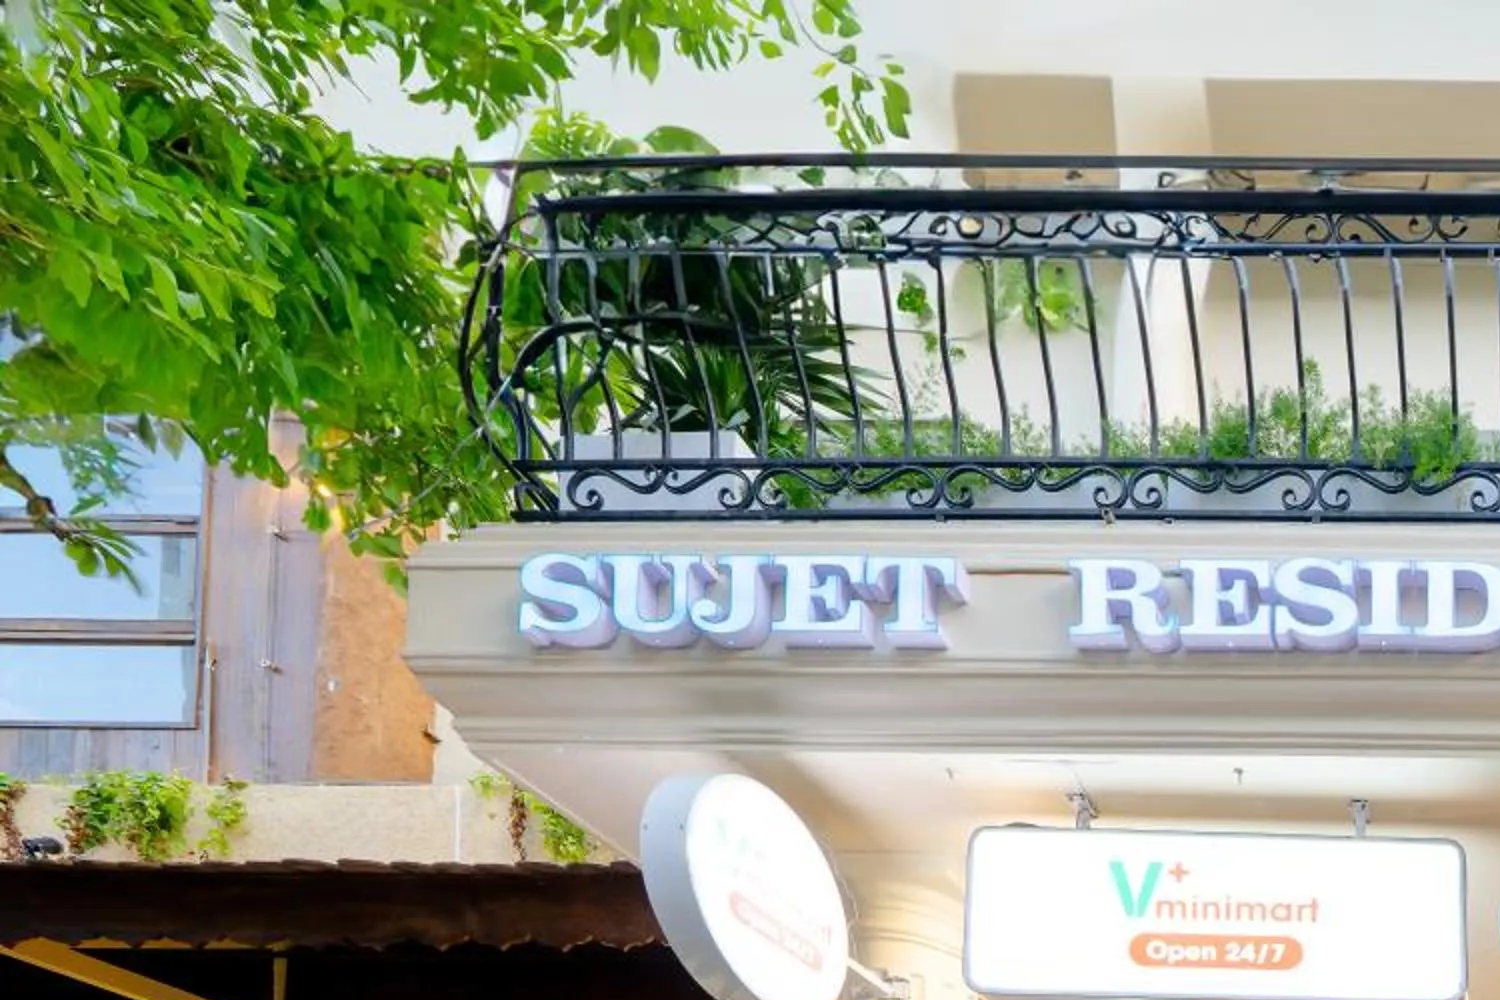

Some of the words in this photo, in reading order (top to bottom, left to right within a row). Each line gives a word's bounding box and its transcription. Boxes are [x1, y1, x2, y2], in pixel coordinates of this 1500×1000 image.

[518, 553, 966, 649] SUJET
[1155, 895, 1319, 924] minimart
[1145, 939, 1217, 967] Open
[1224, 940, 1287, 965] 24/7
